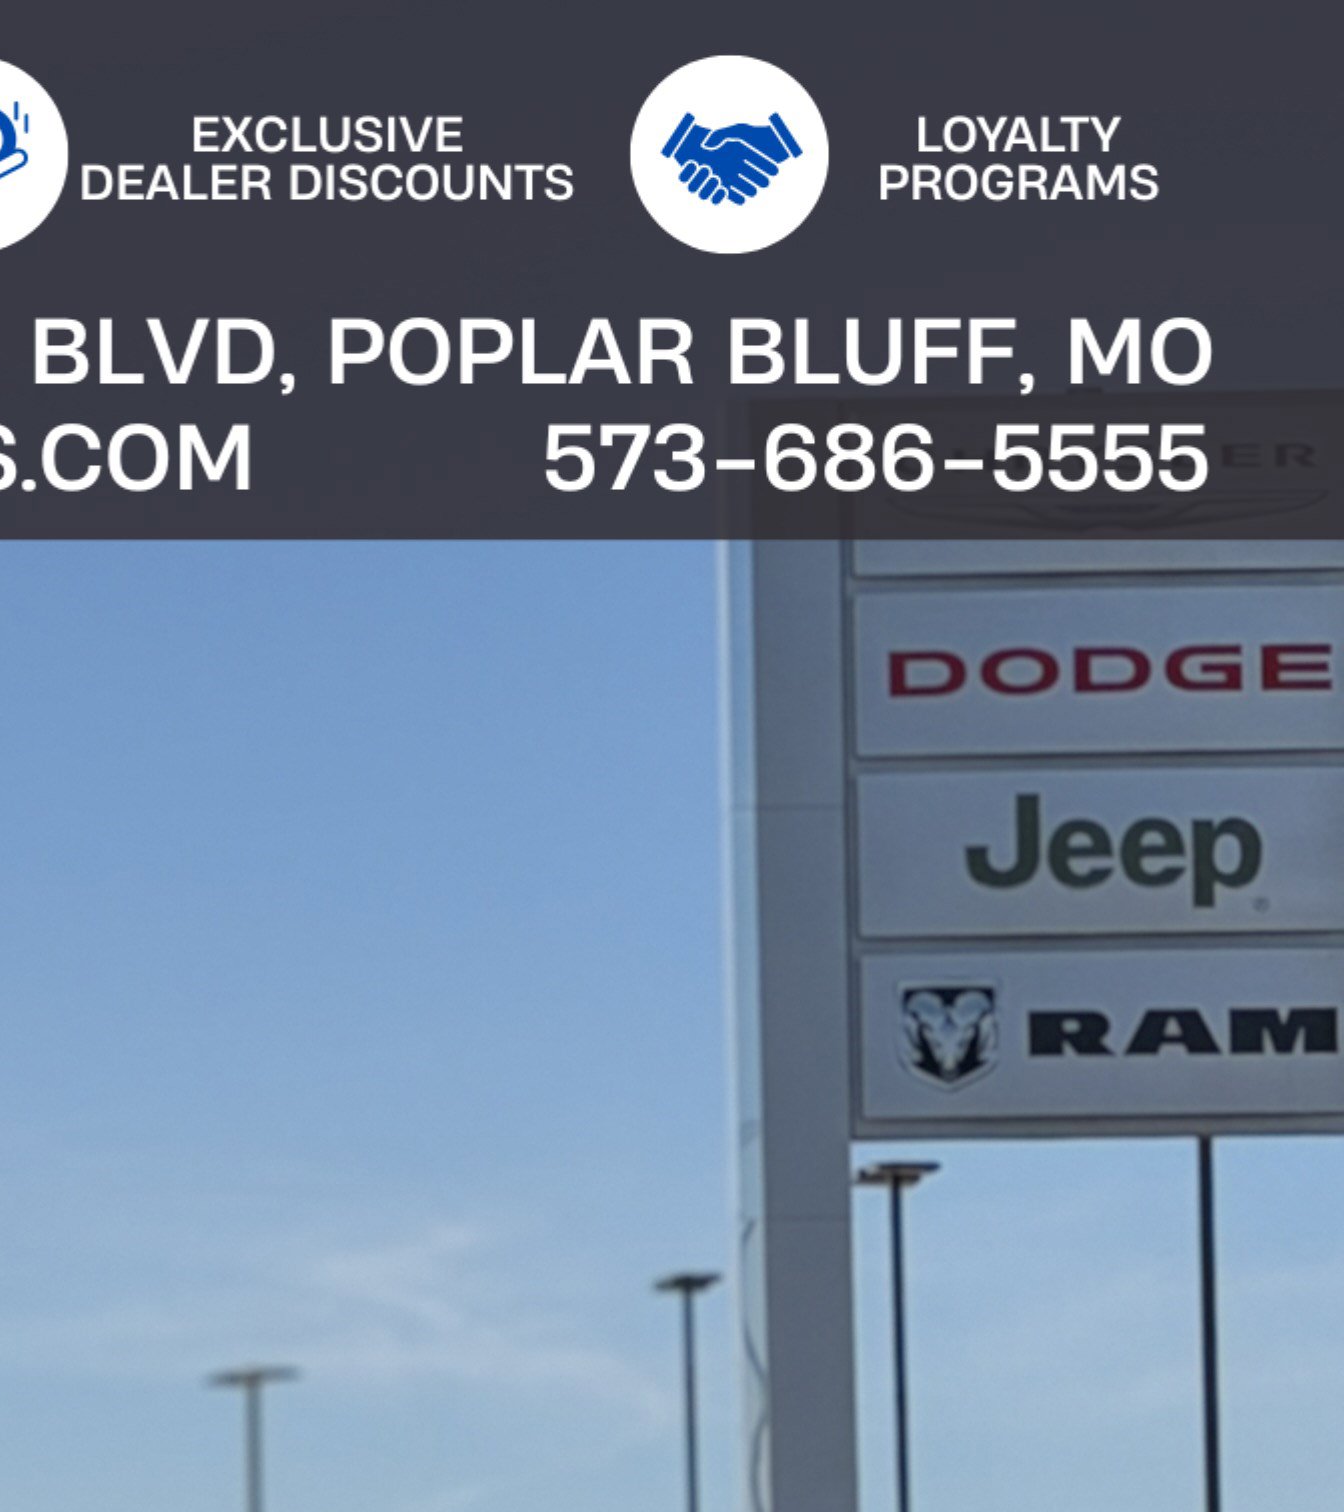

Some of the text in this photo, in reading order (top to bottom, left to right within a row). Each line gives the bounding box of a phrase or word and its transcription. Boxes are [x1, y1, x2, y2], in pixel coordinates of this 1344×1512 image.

[888, 643, 1333, 697] DODGE
[964, 793, 1263, 909] Jeep
[1027, 1006, 1339, 1058] RAM
